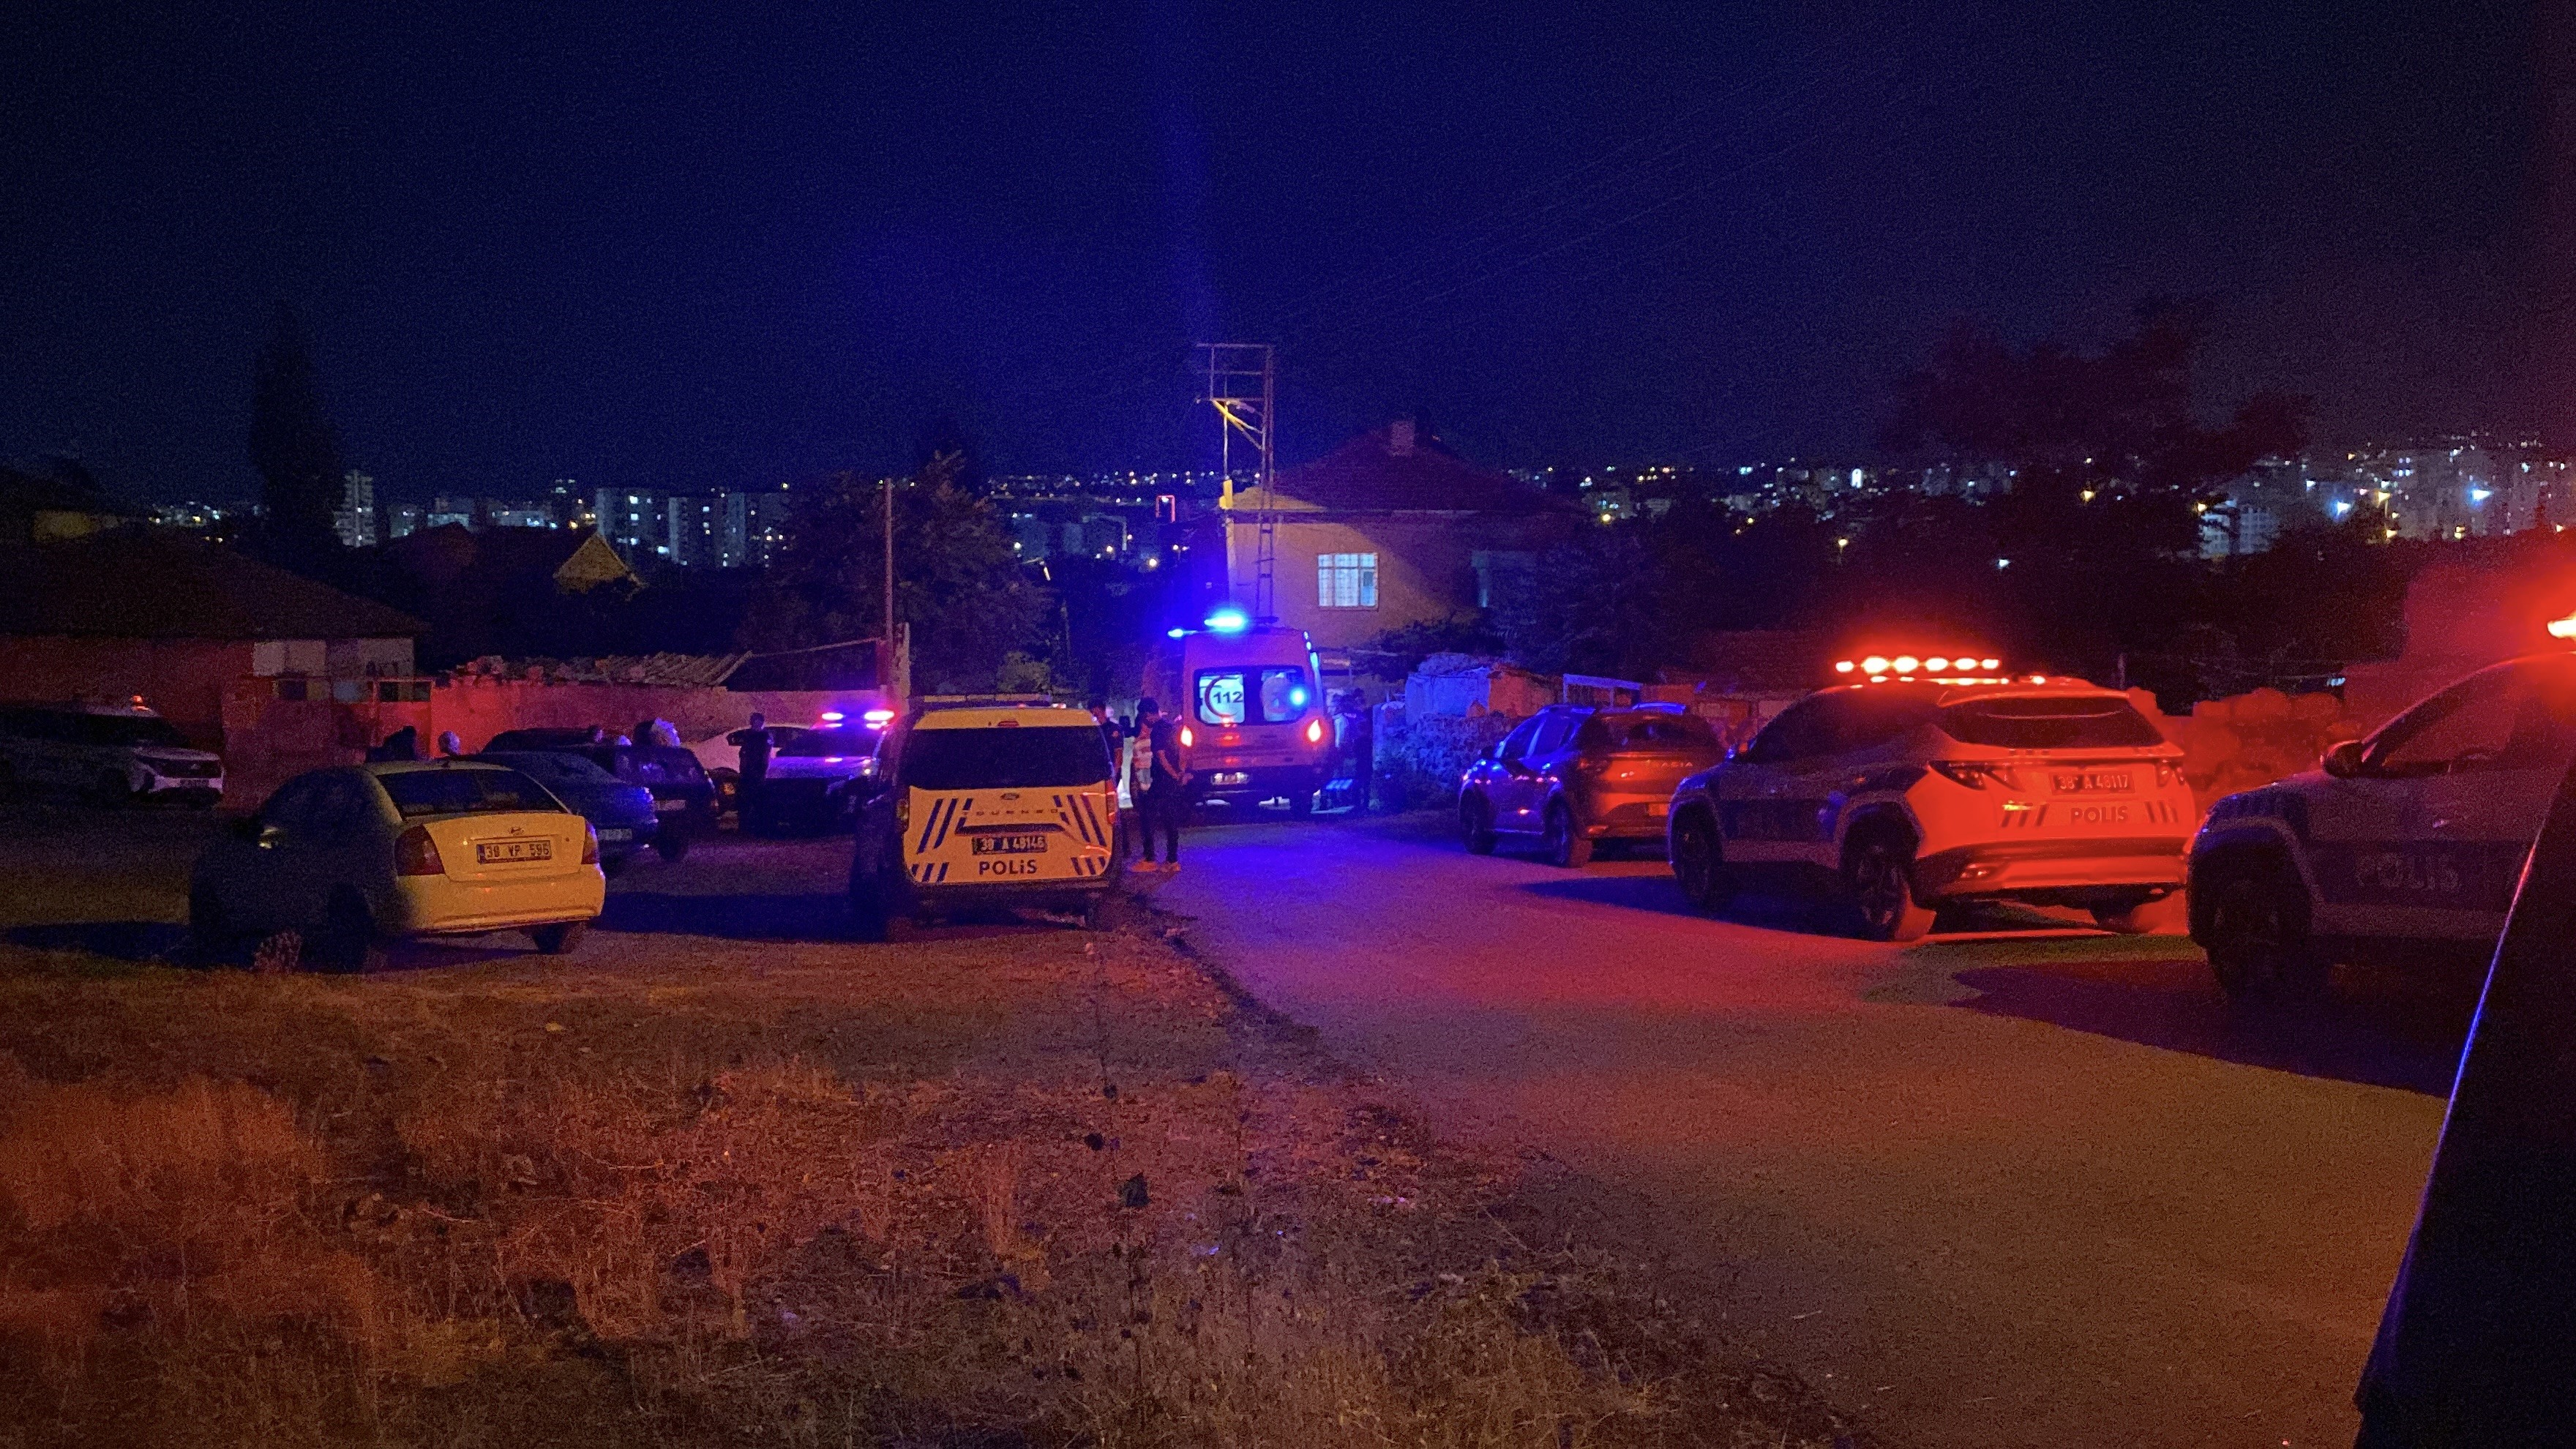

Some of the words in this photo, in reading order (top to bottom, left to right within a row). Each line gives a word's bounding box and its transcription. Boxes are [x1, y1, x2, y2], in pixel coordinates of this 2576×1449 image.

[1213, 691, 1243, 703] 112
[2059, 776, 2075, 790] 38
[2084, 776, 2093, 789] A
[1001, 837, 1010, 850] A
